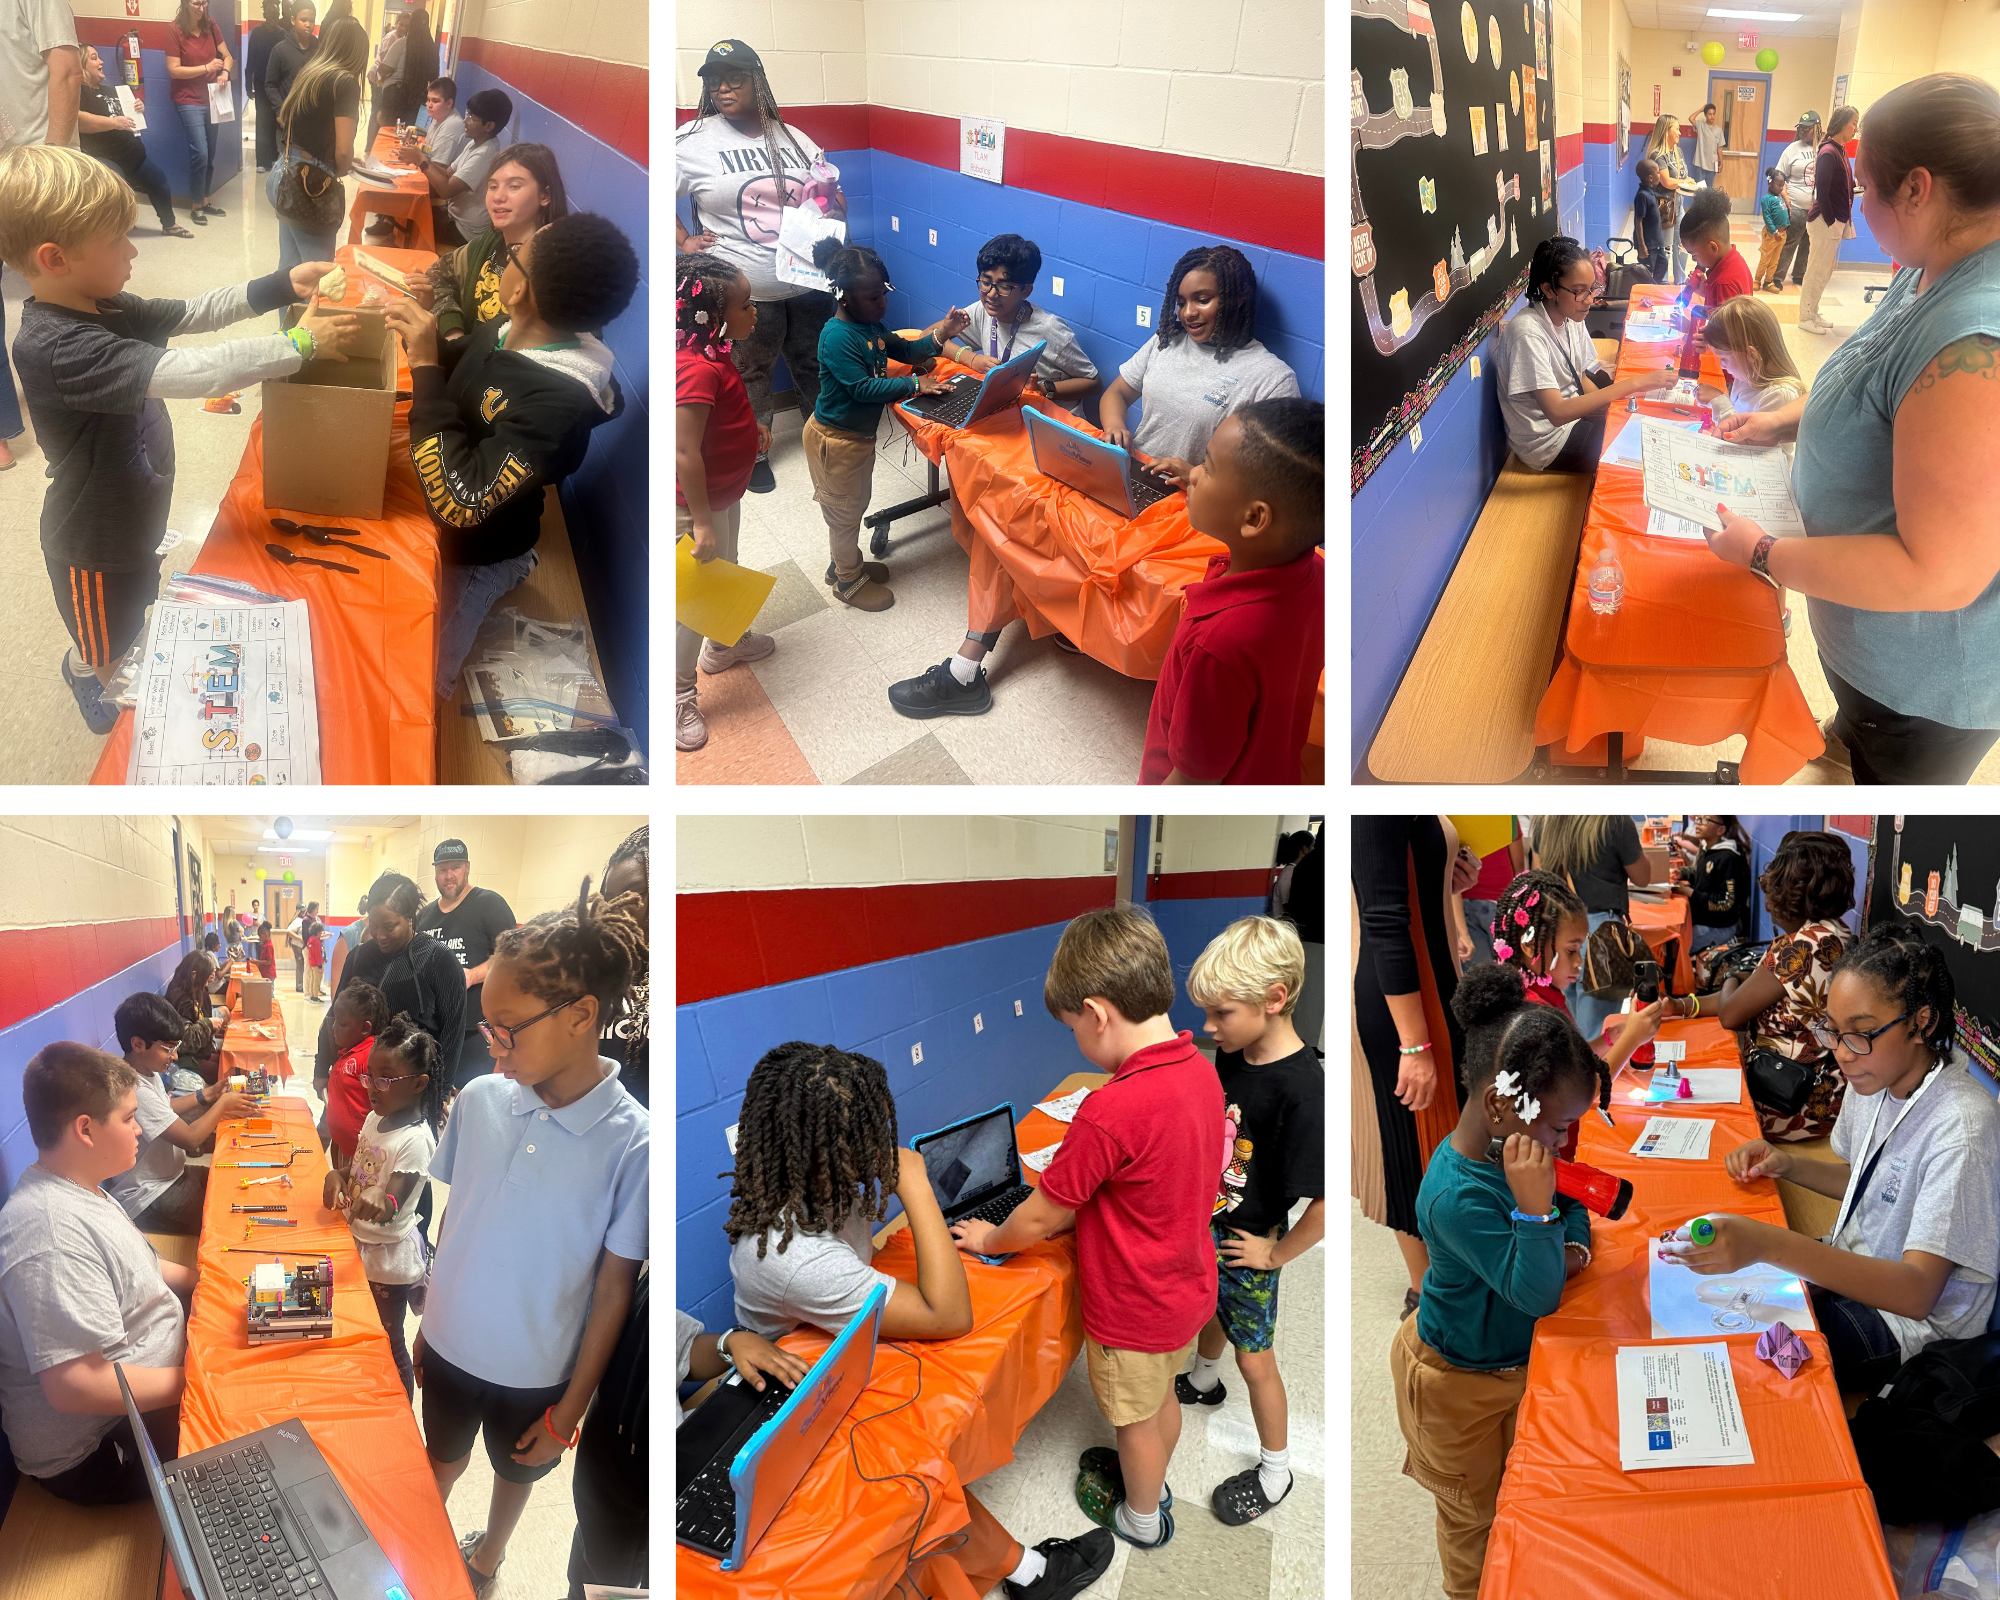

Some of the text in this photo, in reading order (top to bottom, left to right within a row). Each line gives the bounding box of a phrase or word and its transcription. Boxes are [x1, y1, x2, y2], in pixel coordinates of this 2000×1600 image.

[1742, 34, 1757, 48] EXIT
[967, 129, 996, 149] STEM
[970, 163, 991, 176] Robotics
[1353, 232, 1370, 251] NEVER
[1354, 250, 1367, 269] GIVE
[1140, 310, 1147, 322] 5
[412, 436, 478, 528] RELIGION
[482, 457, 532, 511] TRUE
[1679, 462, 1755, 495] STEM
[201, 643, 242, 751] STEM
[915, 1047, 920, 1060] 8
[276, 1429, 300, 1443] ThinkPad
